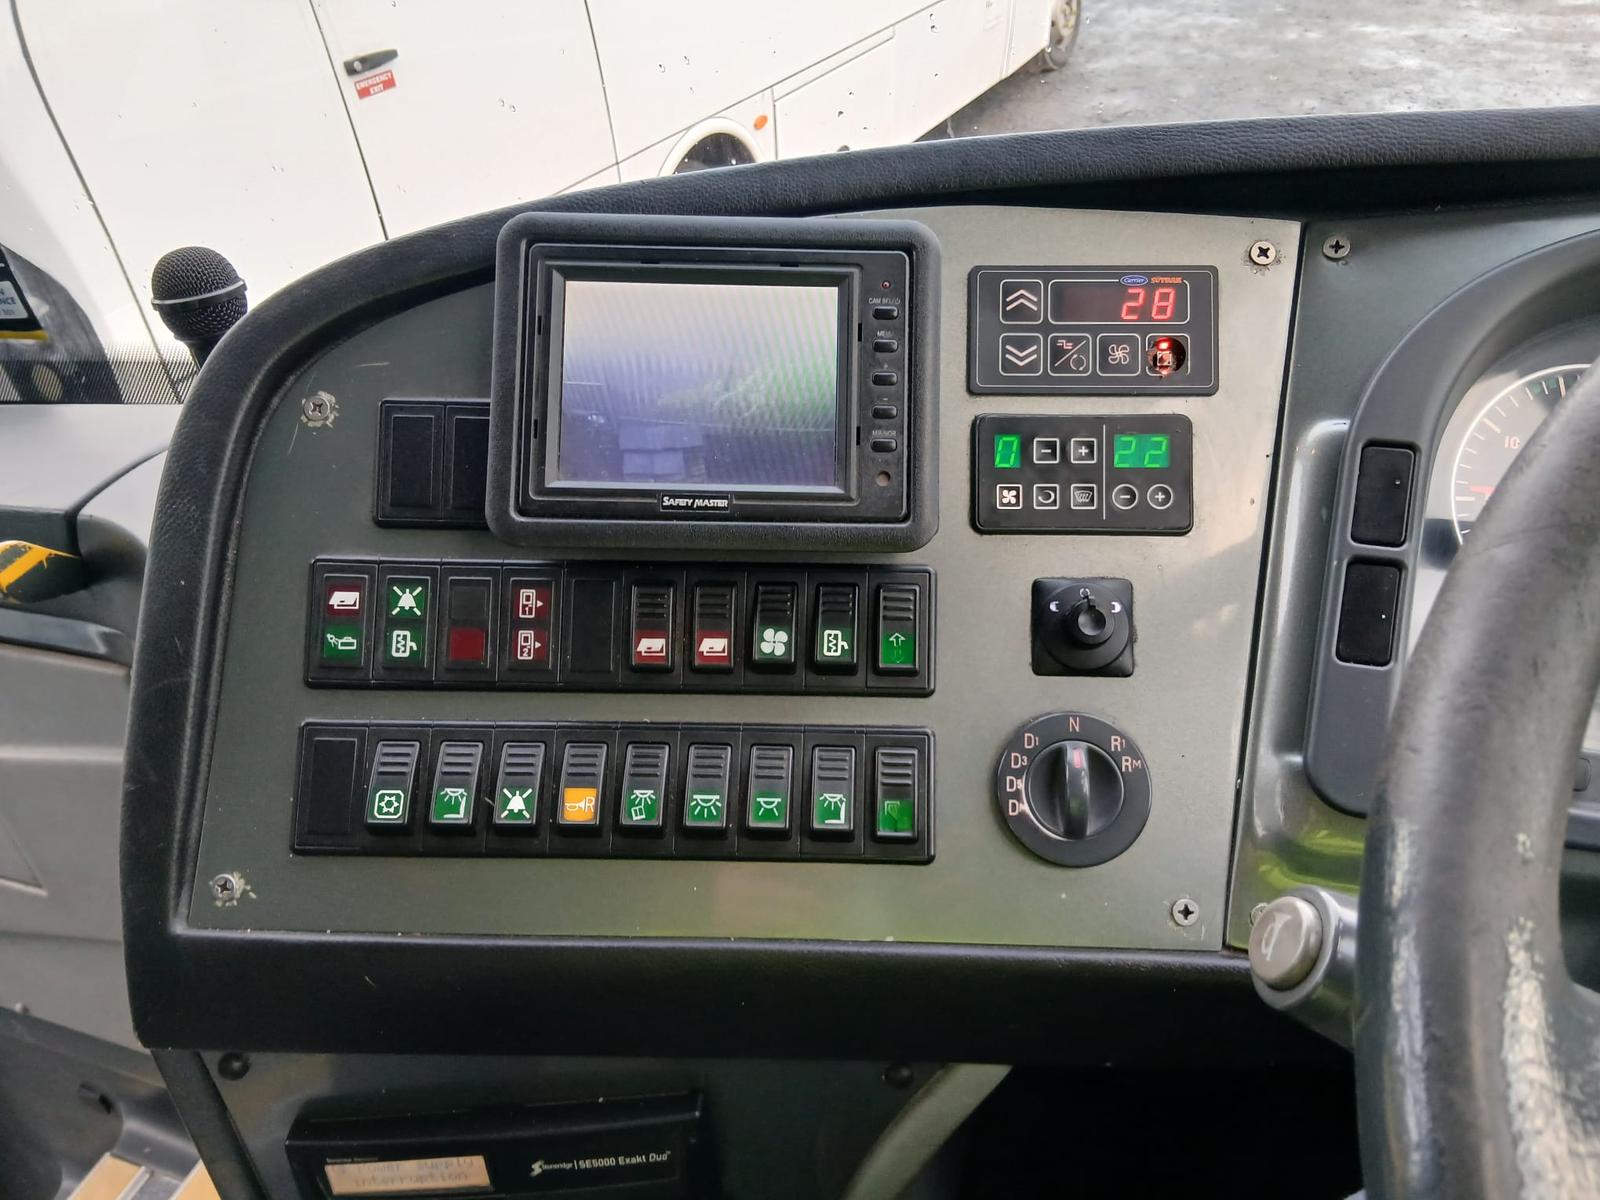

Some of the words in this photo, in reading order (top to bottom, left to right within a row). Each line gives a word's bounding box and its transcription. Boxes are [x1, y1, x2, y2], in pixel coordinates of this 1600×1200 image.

[1122, 276, 1147, 285] Carrier
[1121, 287, 1176, 320] 28
[1504, 436, 1521, 449] 10
[995, 436, 1018, 468] 0
[1113, 436, 1168, 468] 22
[662, 496, 693, 507] SAFETY
[693, 498, 729, 509] MASTER
[1069, 716, 1080, 732] N
[1011, 753, 1028, 769] D3
[585, 796, 595, 813] R
[618, 1154, 646, 1166] Exakt
